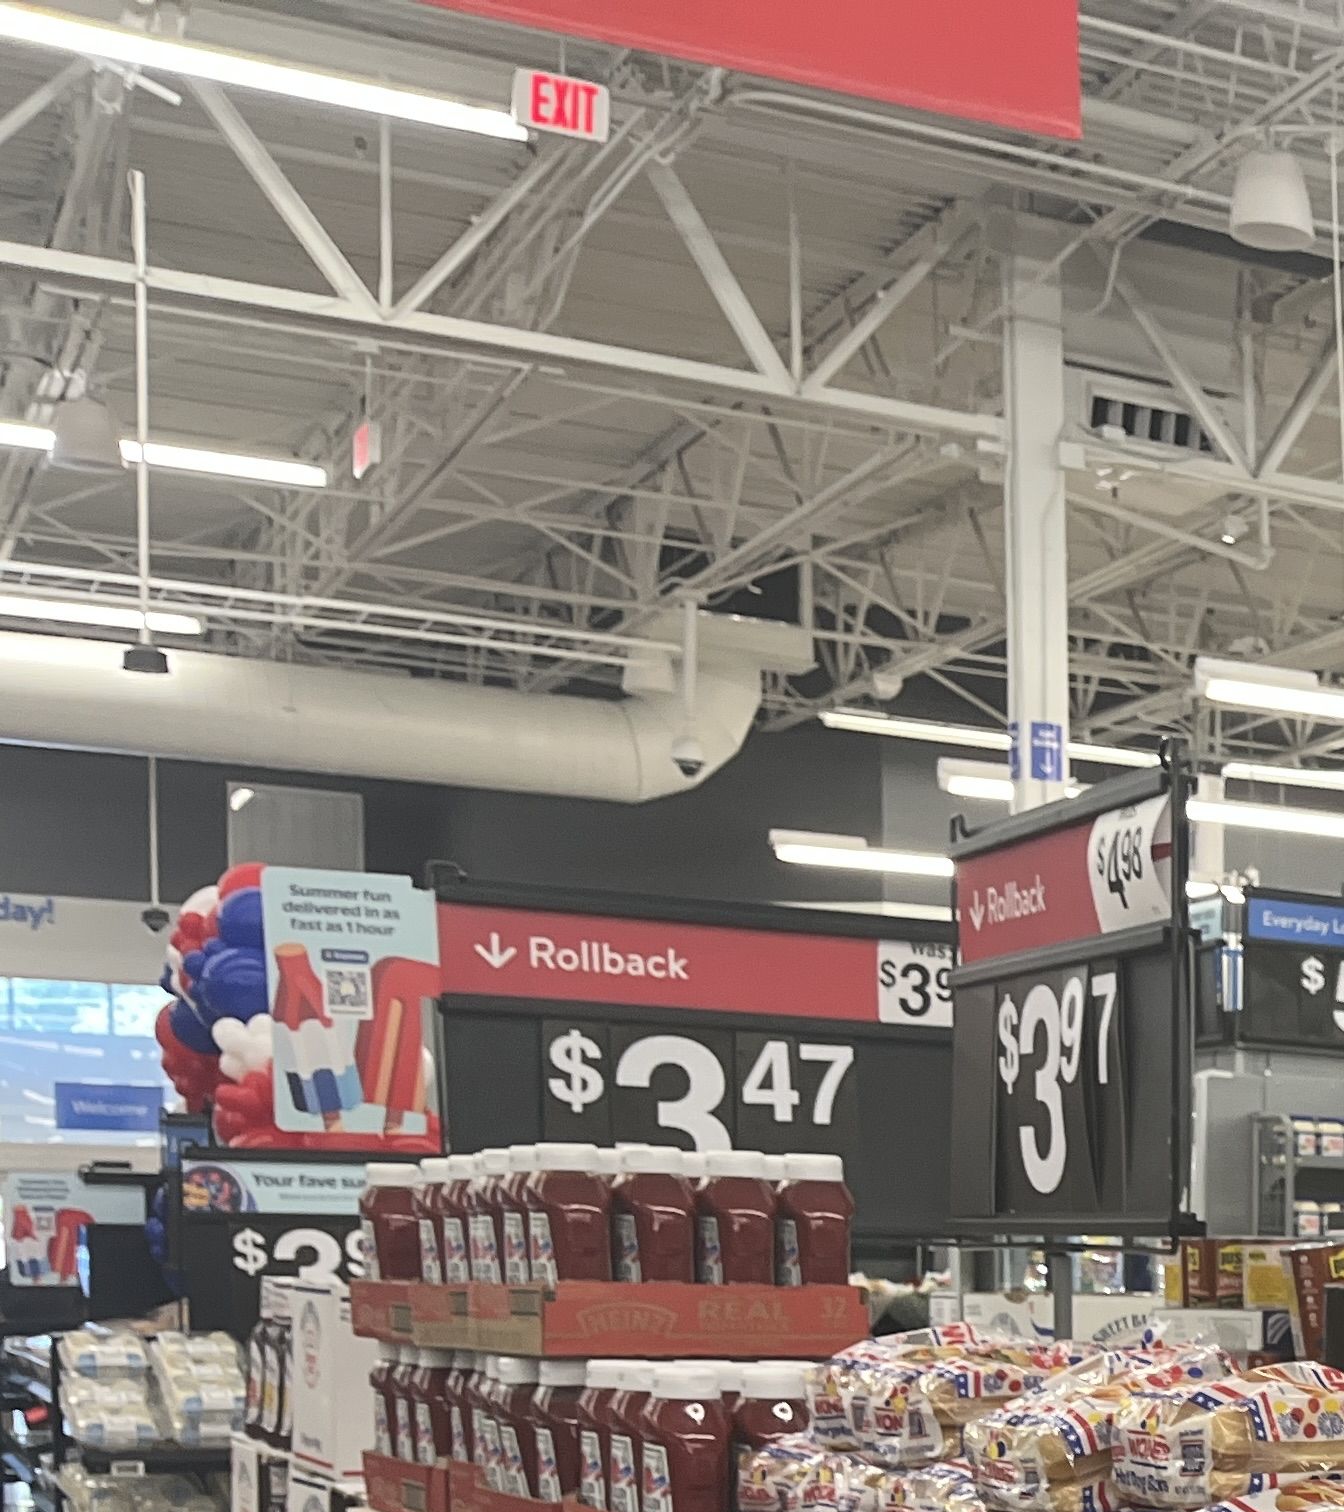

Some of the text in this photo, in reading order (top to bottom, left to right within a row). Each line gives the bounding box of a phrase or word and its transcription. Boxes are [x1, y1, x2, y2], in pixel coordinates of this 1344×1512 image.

[530, 74, 600, 134] EXIT
[289, 884, 393, 903] Summer fun
[986, 875, 1046, 926] Rollback
[282, 901, 401, 920] delivered in as
[1262, 908, 1329, 938] Everyday
[290, 917, 322, 932] fast
[325, 920, 344, 933] as
[355, 921, 397, 937] hour
[528, 937, 690, 982] Rollback
[255, 1175, 337, 1191] Your fave
